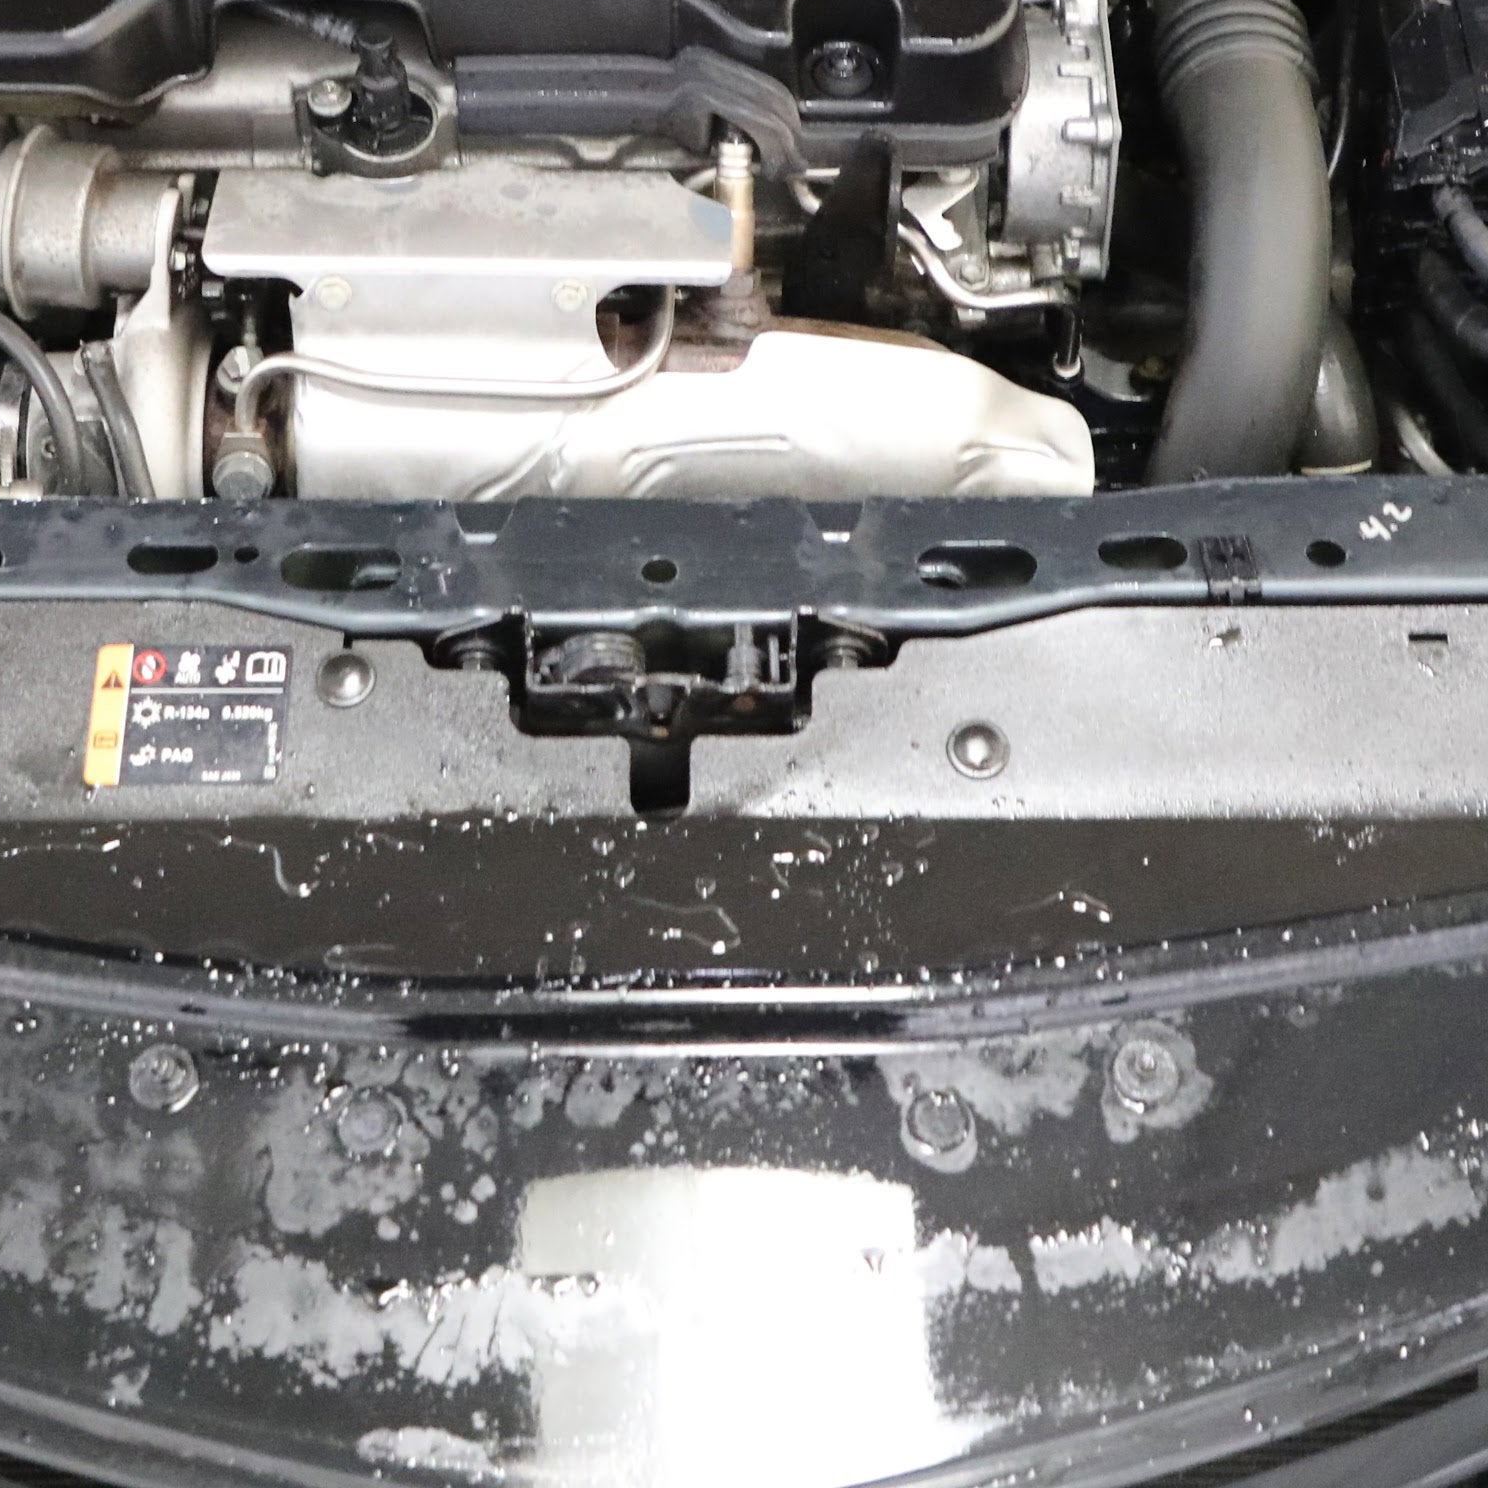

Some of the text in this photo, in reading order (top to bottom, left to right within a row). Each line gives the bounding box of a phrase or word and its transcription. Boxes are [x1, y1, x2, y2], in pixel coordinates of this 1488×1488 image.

[175, 671, 201, 684] AUTO
[163, 705, 210, 720] R-134a
[161, 747, 194, 764] PAG
